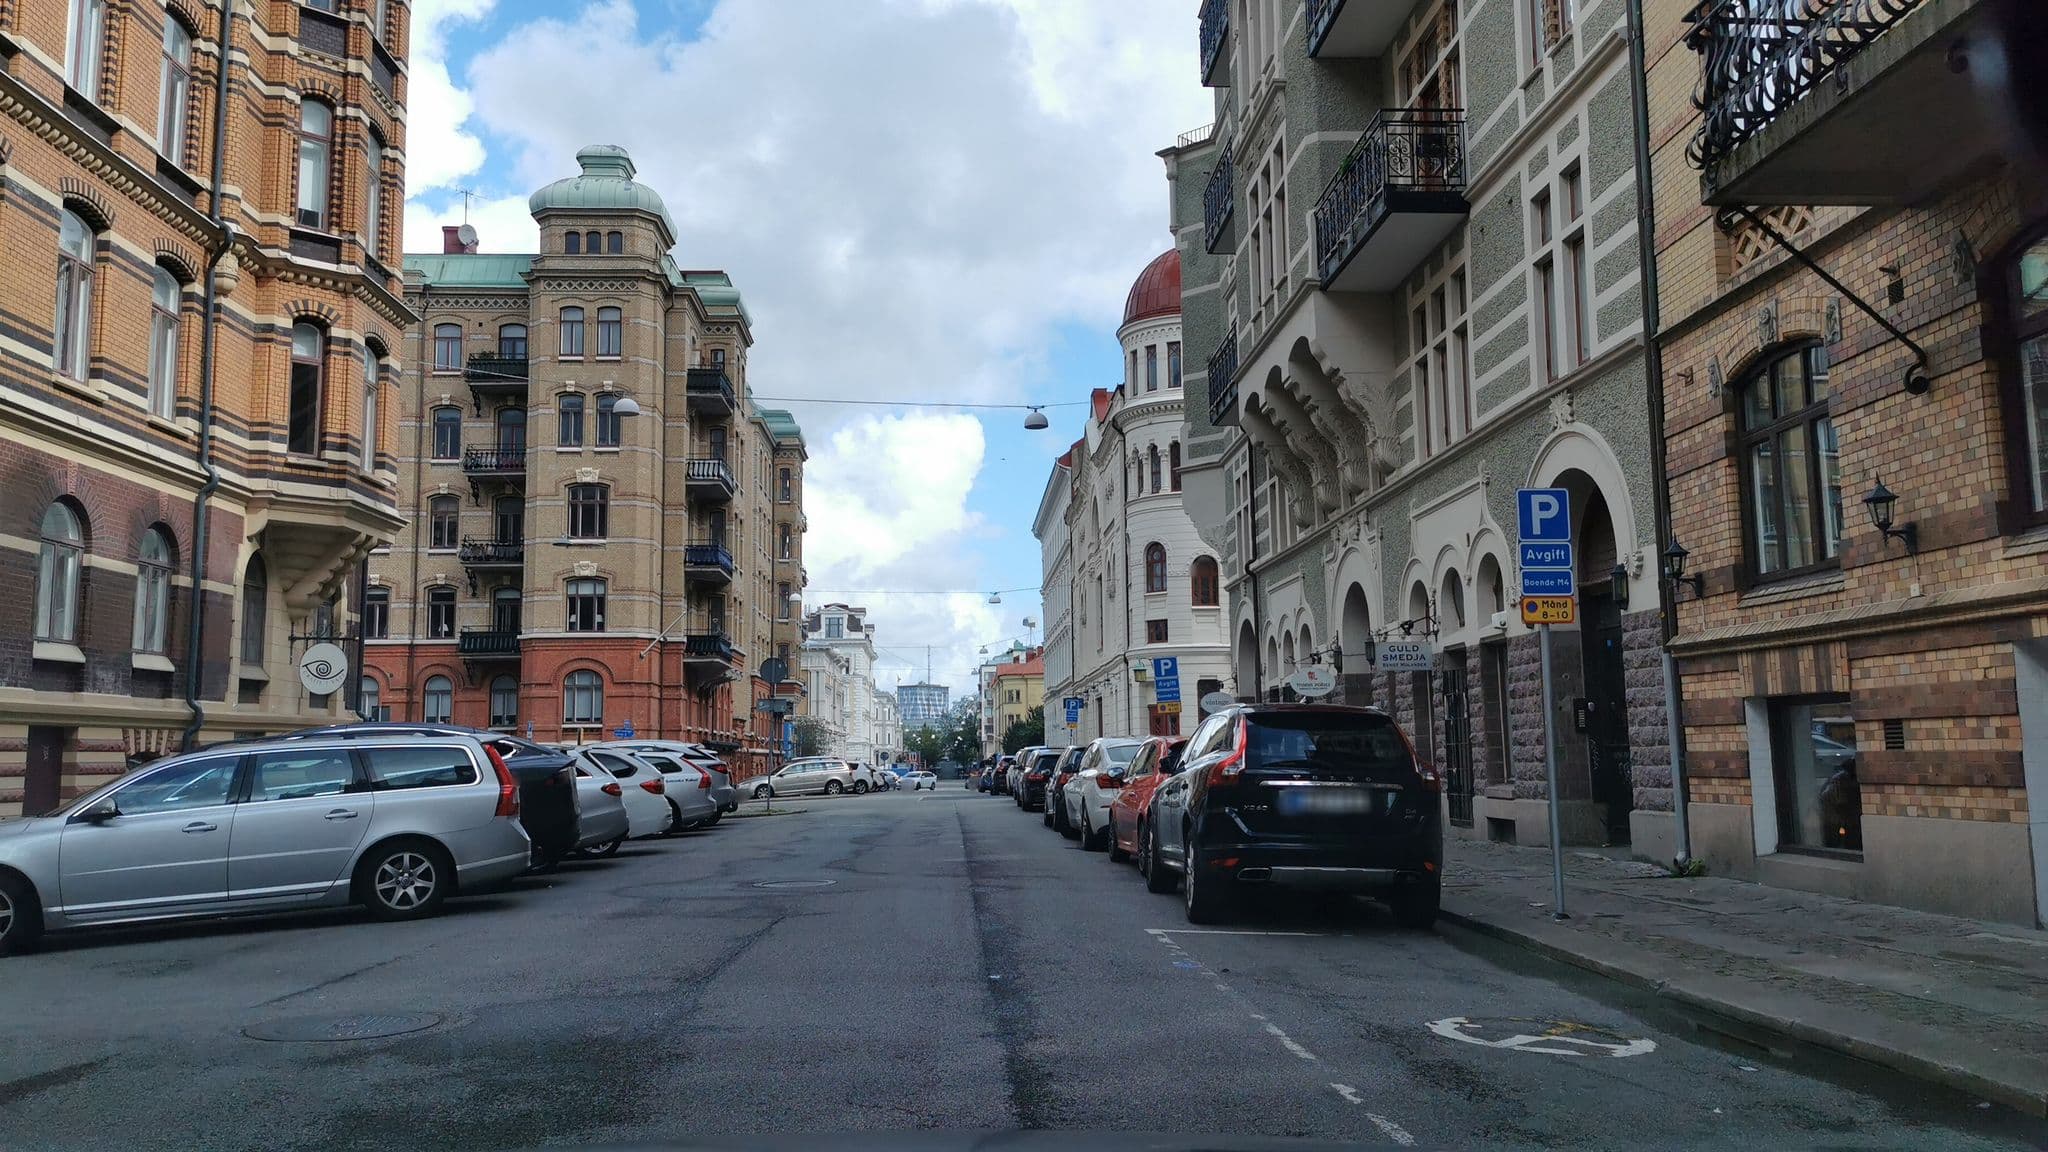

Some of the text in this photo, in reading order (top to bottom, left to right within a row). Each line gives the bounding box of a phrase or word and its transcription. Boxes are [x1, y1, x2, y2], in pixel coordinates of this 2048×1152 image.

[1531, 494, 1560, 535] P
[1526, 549, 1566, 562] Avgift
[1524, 578, 1570, 586] Boende M4
[1541, 600, 1568, 609] Månd
[1542, 610, 1569, 619] 8-10
[1388, 645, 1419, 653] GULD
[1160, 659, 1172, 676] P
[1070, 701, 1077, 710] P
